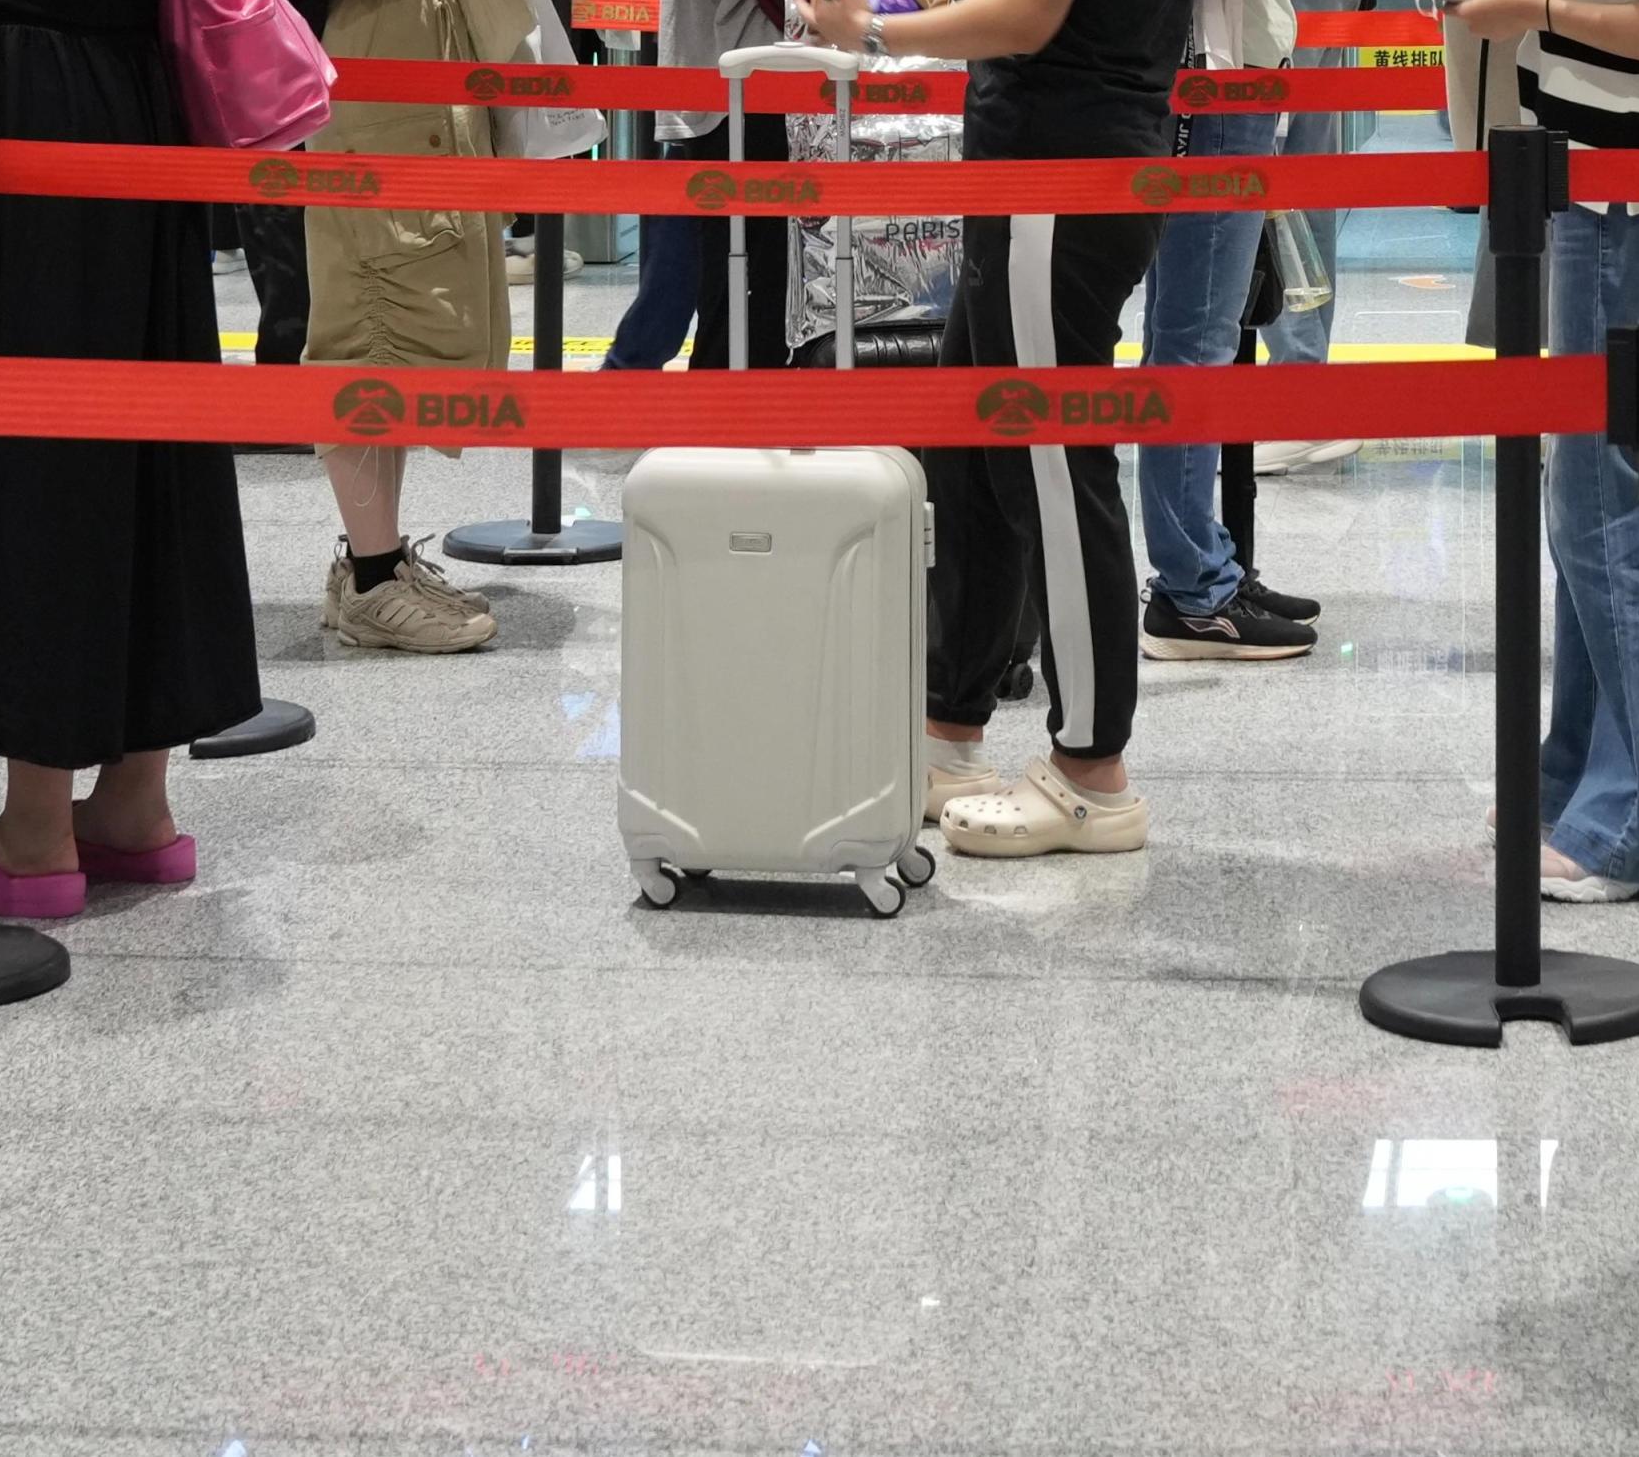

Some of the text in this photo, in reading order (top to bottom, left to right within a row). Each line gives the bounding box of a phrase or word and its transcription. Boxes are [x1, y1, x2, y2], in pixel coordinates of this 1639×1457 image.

[601, 5, 650, 22] BDIA
[511, 76, 571, 96] BDIA
[307, 169, 381, 195] BDIA
[744, 178, 821, 204] BDIA
[1187, 172, 1267, 198] BDIA
[884, 218, 961, 239] PARIS
[415, 392, 526, 429] BDIA
[1062, 391, 1172, 426] BDIA
